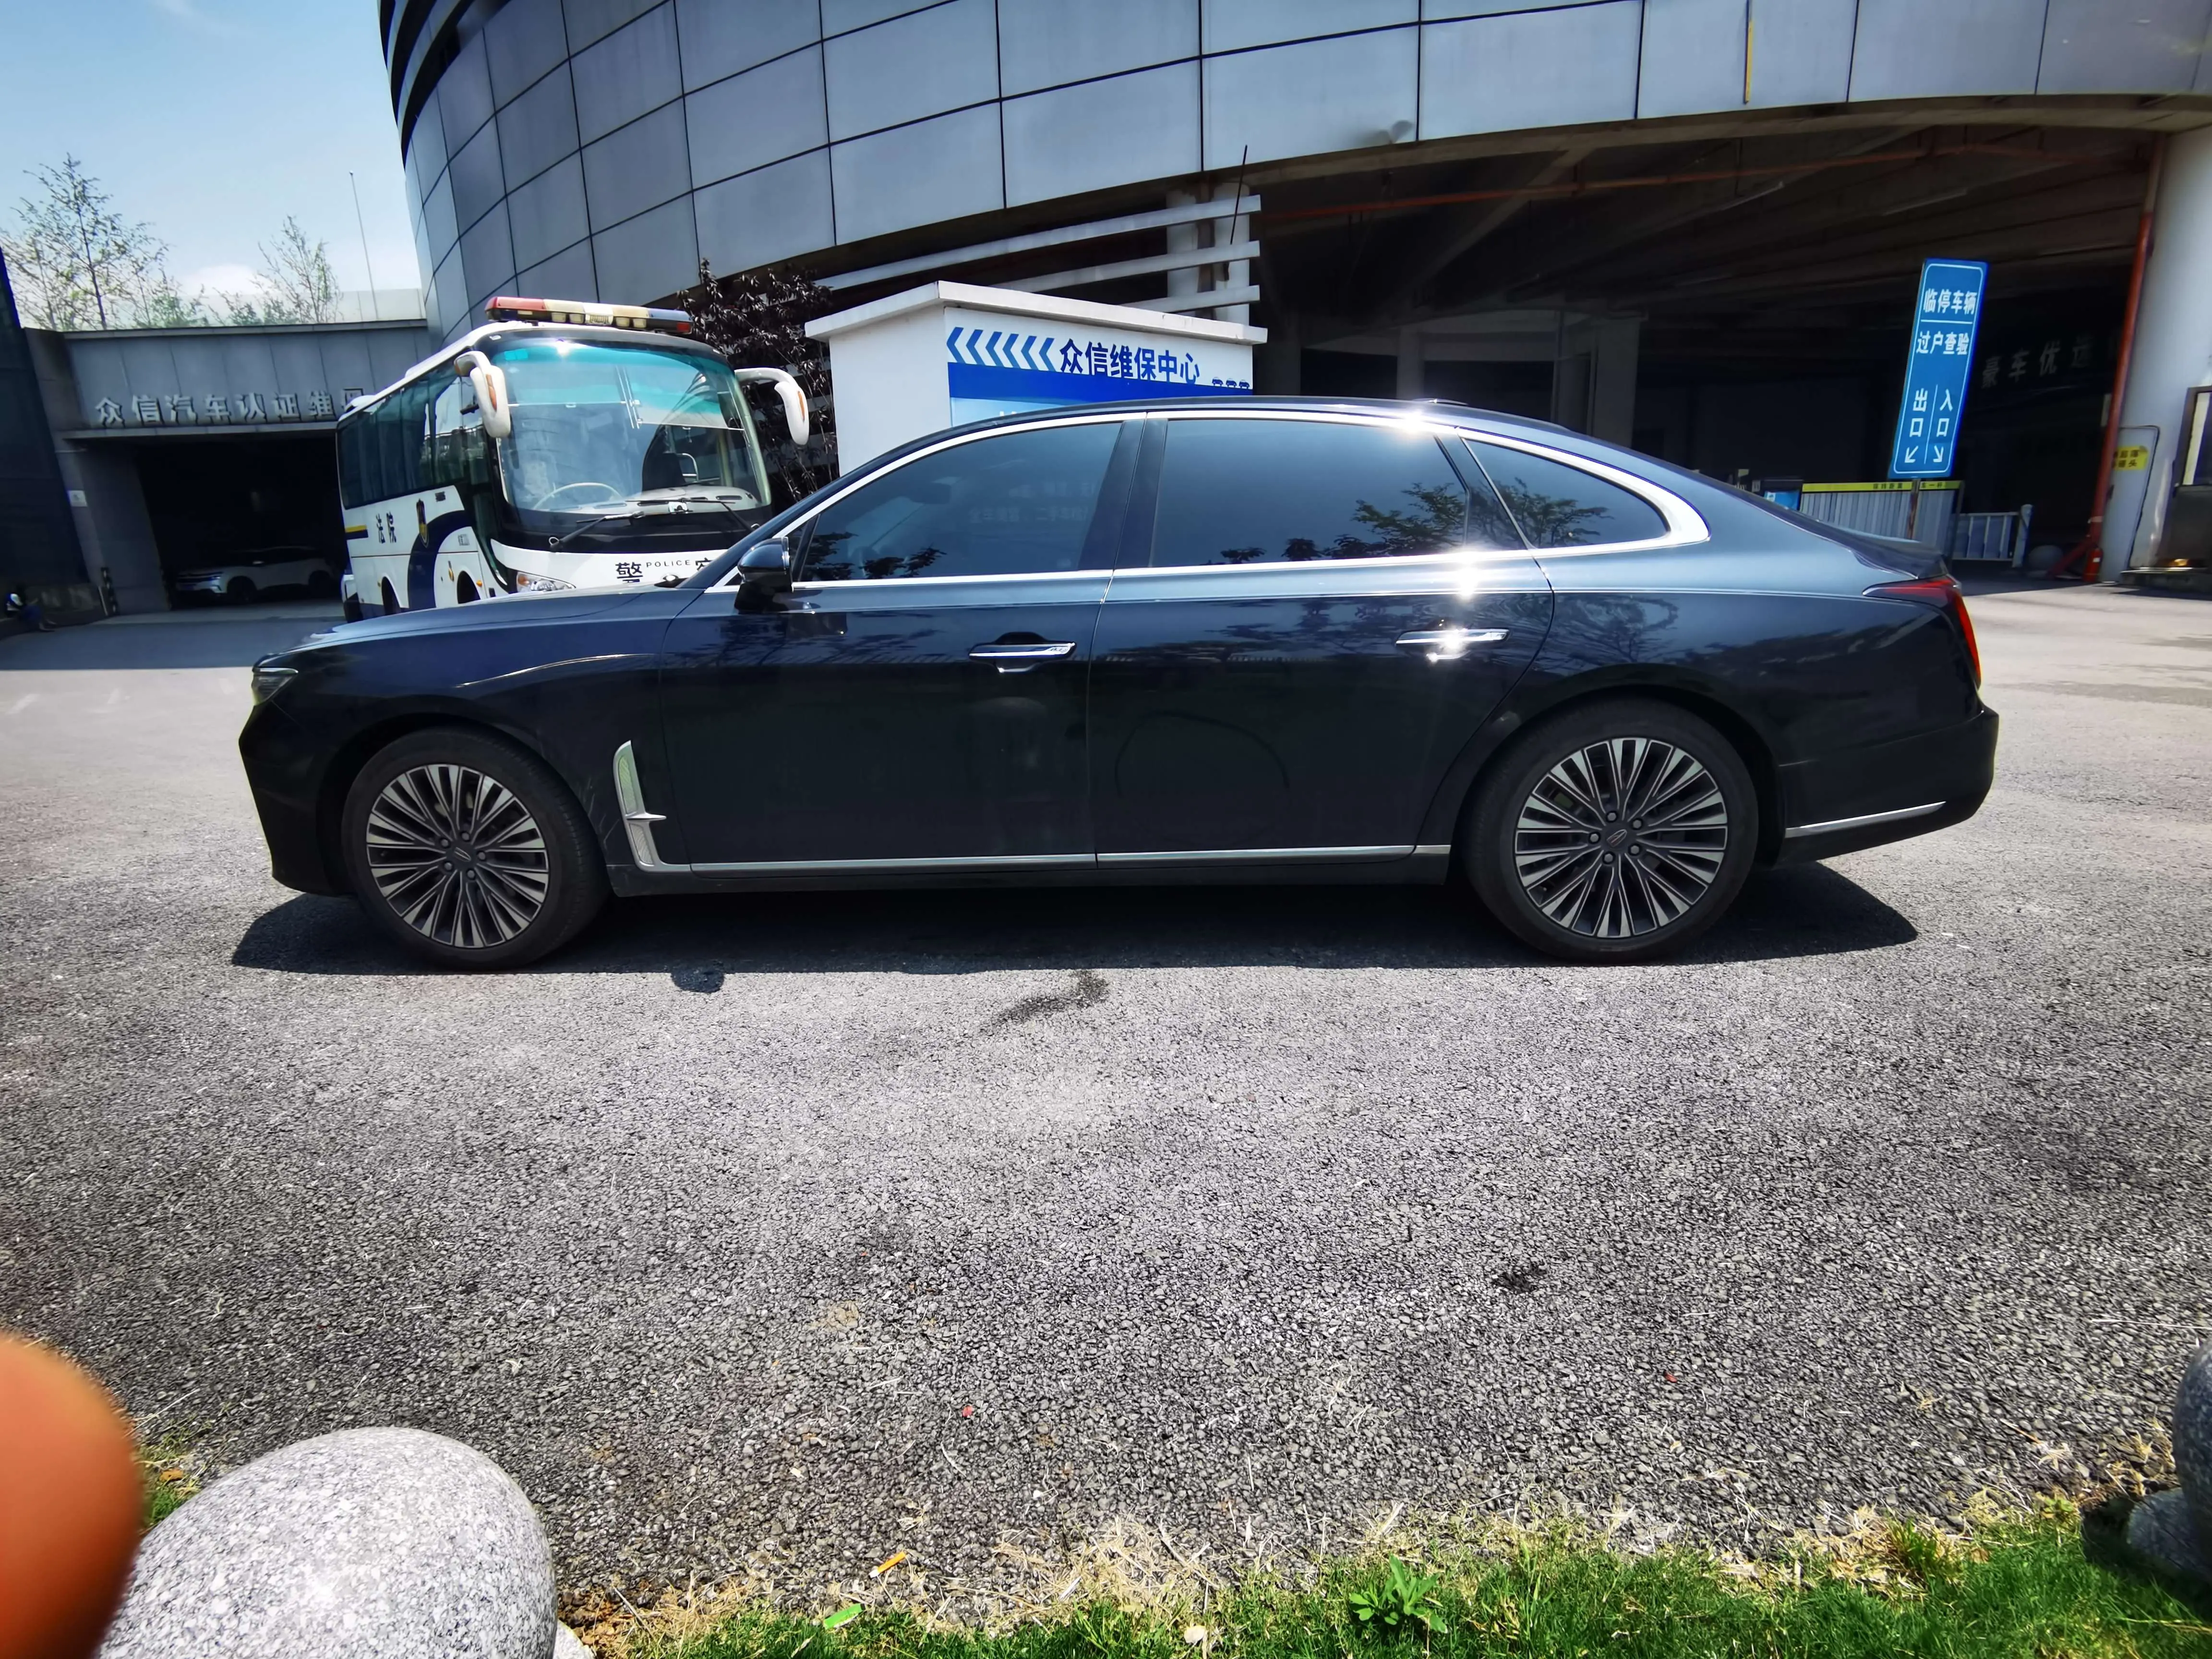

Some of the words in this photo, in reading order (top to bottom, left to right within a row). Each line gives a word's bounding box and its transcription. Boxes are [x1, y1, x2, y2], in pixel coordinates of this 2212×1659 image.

[1923, 288, 1978, 315] 临停车辆
[1059, 338, 1201, 385] 众信维保中心
[1916, 330, 1969, 355] 过户查验
[1981, 330, 2119, 389] 豪车优选
[1909, 387, 1928, 437] 出口
[1936, 388, 1953, 437] 入口
[375, 511, 397, 543] 法院
[615, 561, 644, 583] 警
[646, 560, 691, 568] POLICE
